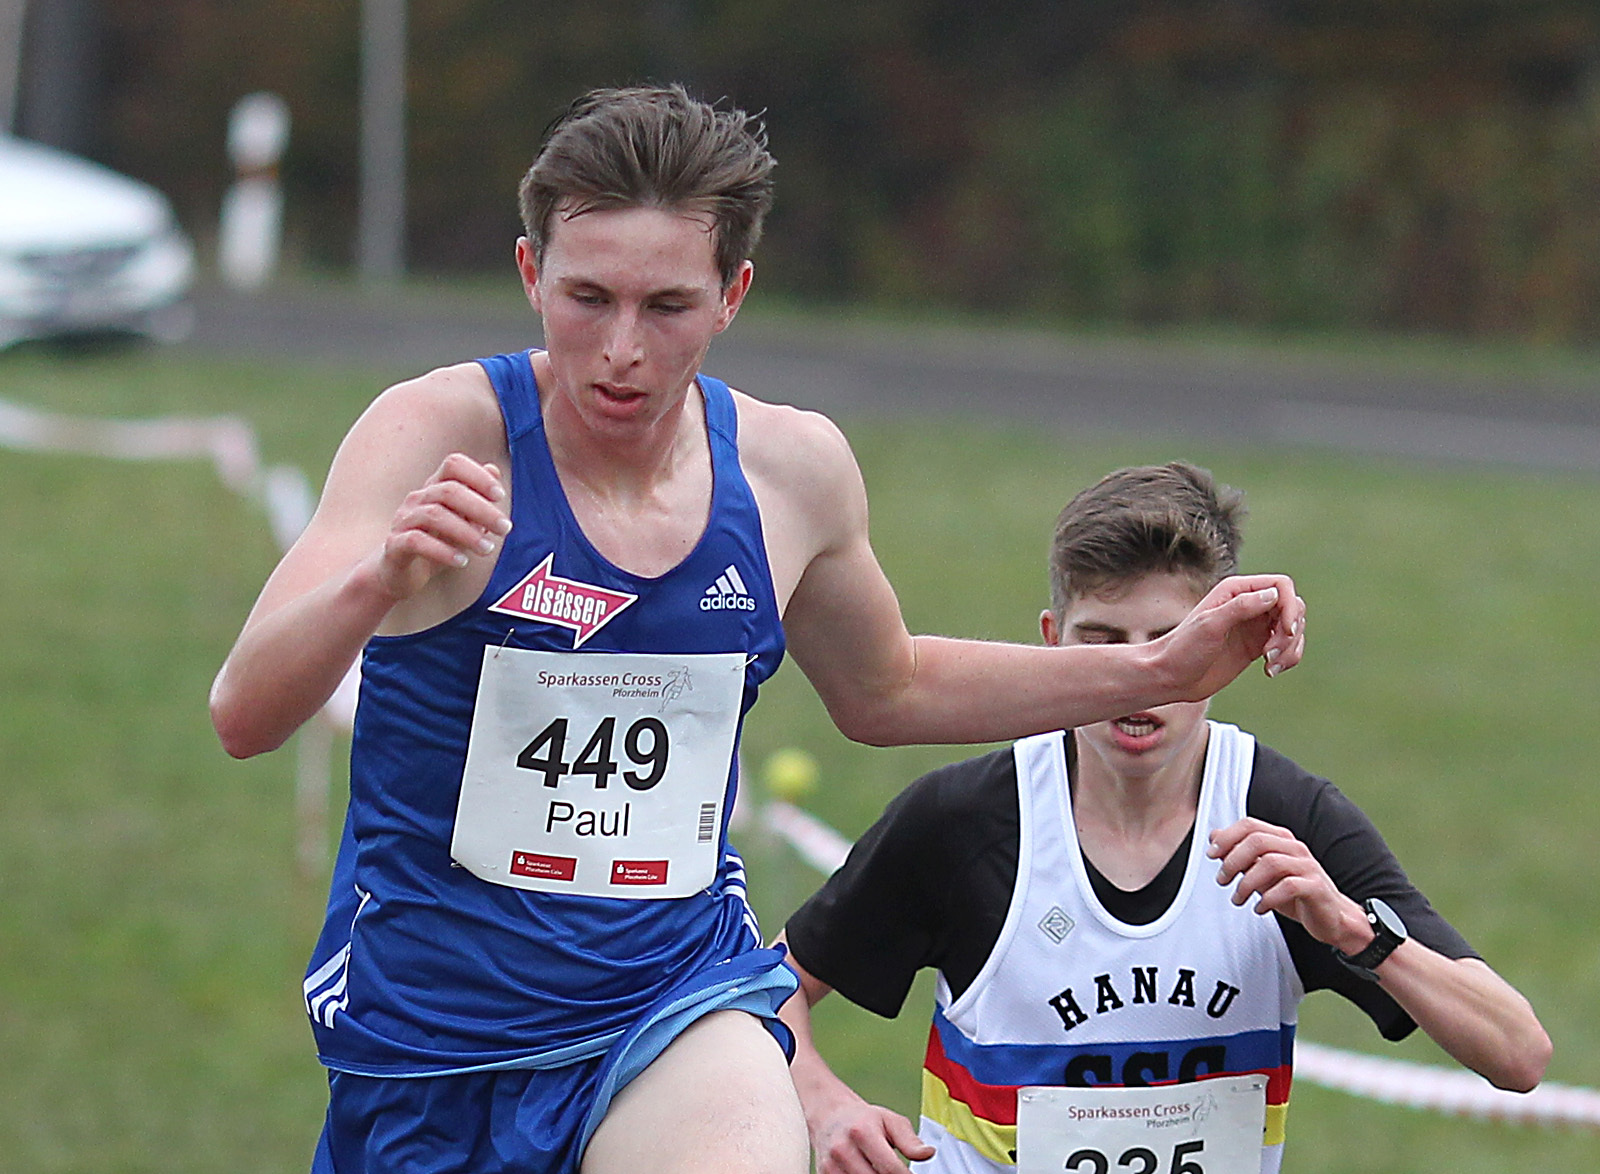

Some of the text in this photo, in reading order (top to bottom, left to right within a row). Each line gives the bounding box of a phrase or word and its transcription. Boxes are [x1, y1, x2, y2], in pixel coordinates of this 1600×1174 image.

[522, 579, 607, 627] elsässer
[699, 593, 756, 612] adidas
[537, 670, 662, 688] Sparkassen Cross
[612, 688, 660, 699] Pforzheim
[516, 717, 670, 791] 449
[546, 801, 631, 837] Paul
[1048, 966, 1241, 1031] HANAU
[1068, 1102, 1191, 1121] Sparkassen Cross
[1146, 1116, 1191, 1129] Pforzheim
